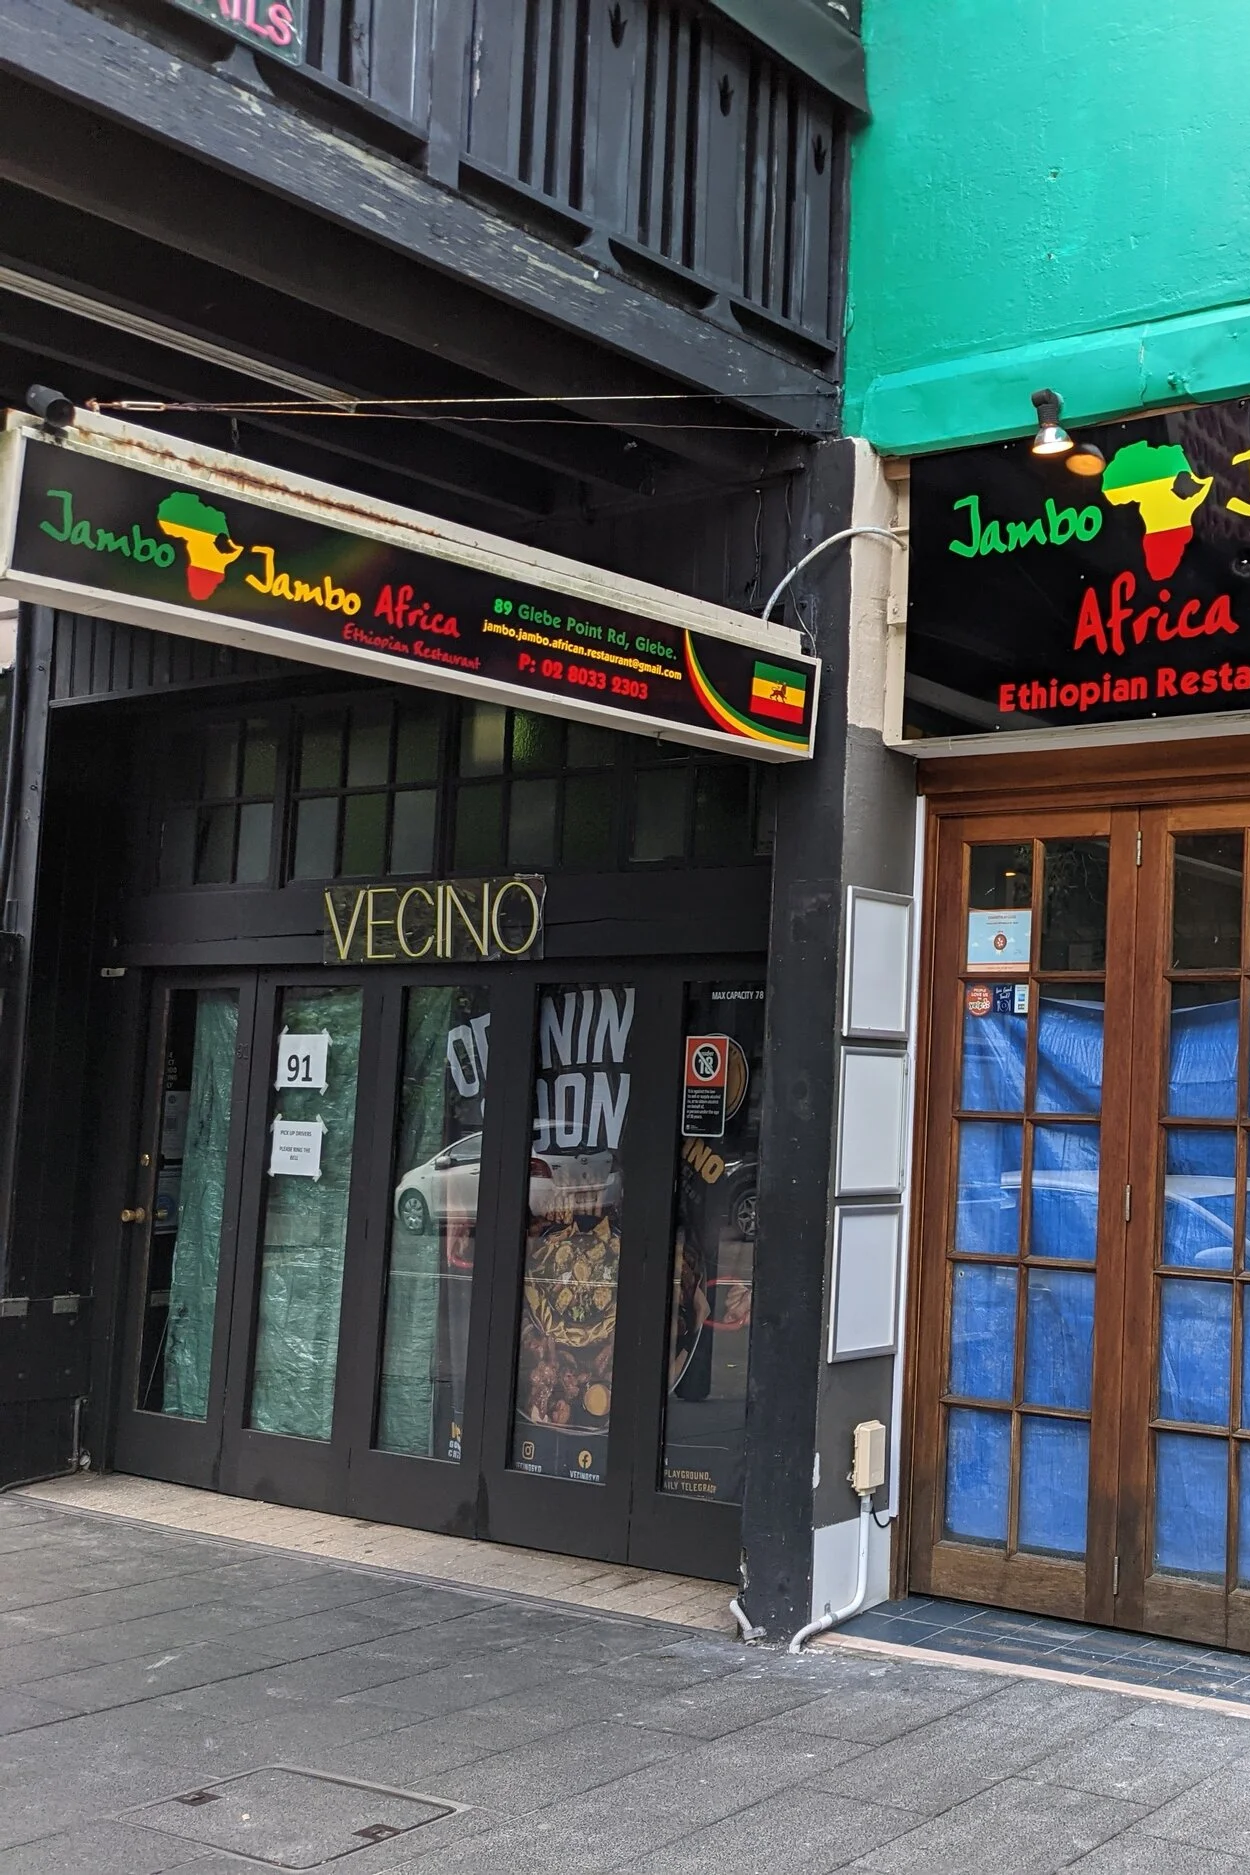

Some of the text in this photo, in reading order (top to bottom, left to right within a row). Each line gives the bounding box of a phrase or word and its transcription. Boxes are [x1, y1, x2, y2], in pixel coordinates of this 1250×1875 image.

[949, 495, 1103, 558] Jambo
[40, 489, 461, 638] Jambo Jambo Africa
[494, 598, 677, 660] 89 Glebe Point Rd, Glebe.
[1073, 570, 1239, 656] Africa
[342, 623, 481, 670] Ethiopian Restaurant
[482, 619, 682, 681] jambo.jambo.african.restaurant@gmail.com
[518, 653, 649, 700] P: 02 8033 2303
[998, 672, 1148, 713] Ethiopian
[325, 881, 540, 960] VECINO
[712, 990, 765, 1000] MAX CAPACITY 78
[287, 1054, 313, 1082] 91
